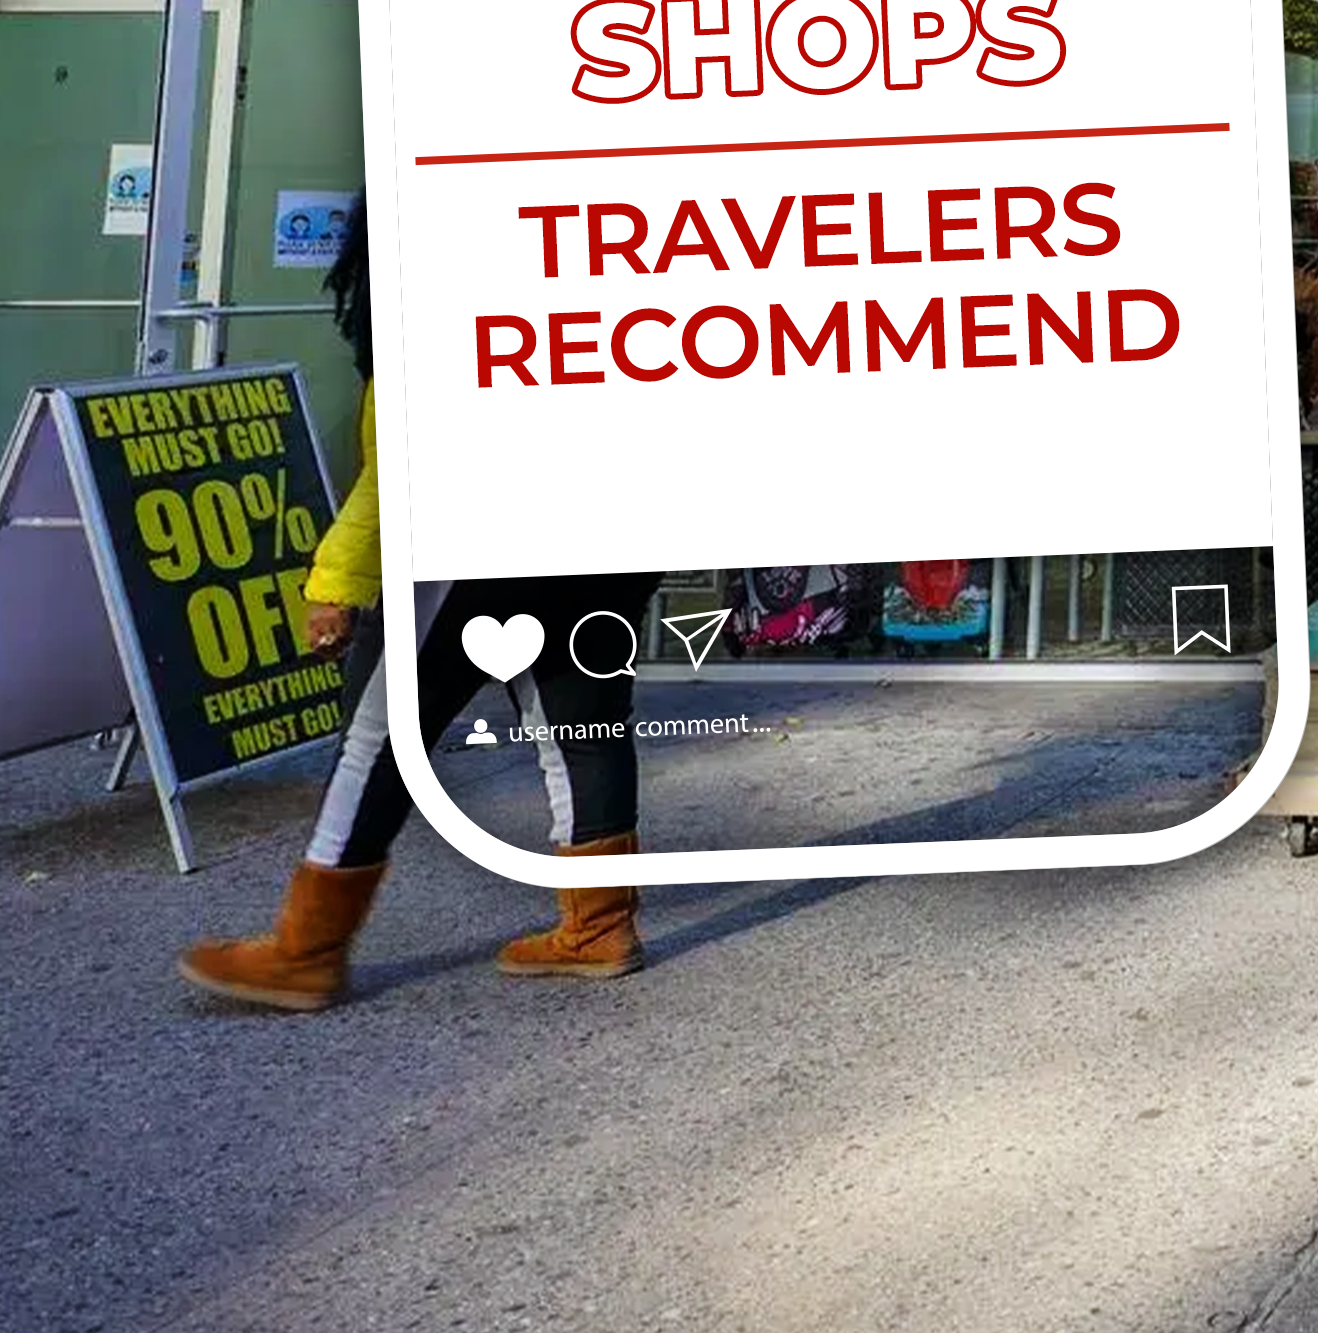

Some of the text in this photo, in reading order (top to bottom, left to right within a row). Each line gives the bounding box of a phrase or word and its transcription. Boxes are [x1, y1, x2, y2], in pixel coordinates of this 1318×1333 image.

[86, 378, 292, 440] EVERYTHING
[120, 419, 286, 478] MUST GO!
[133, 466, 317, 583] 90%
[203, 660, 345, 726] EVERYTHING
[231, 706, 344, 761] MUST GO!
